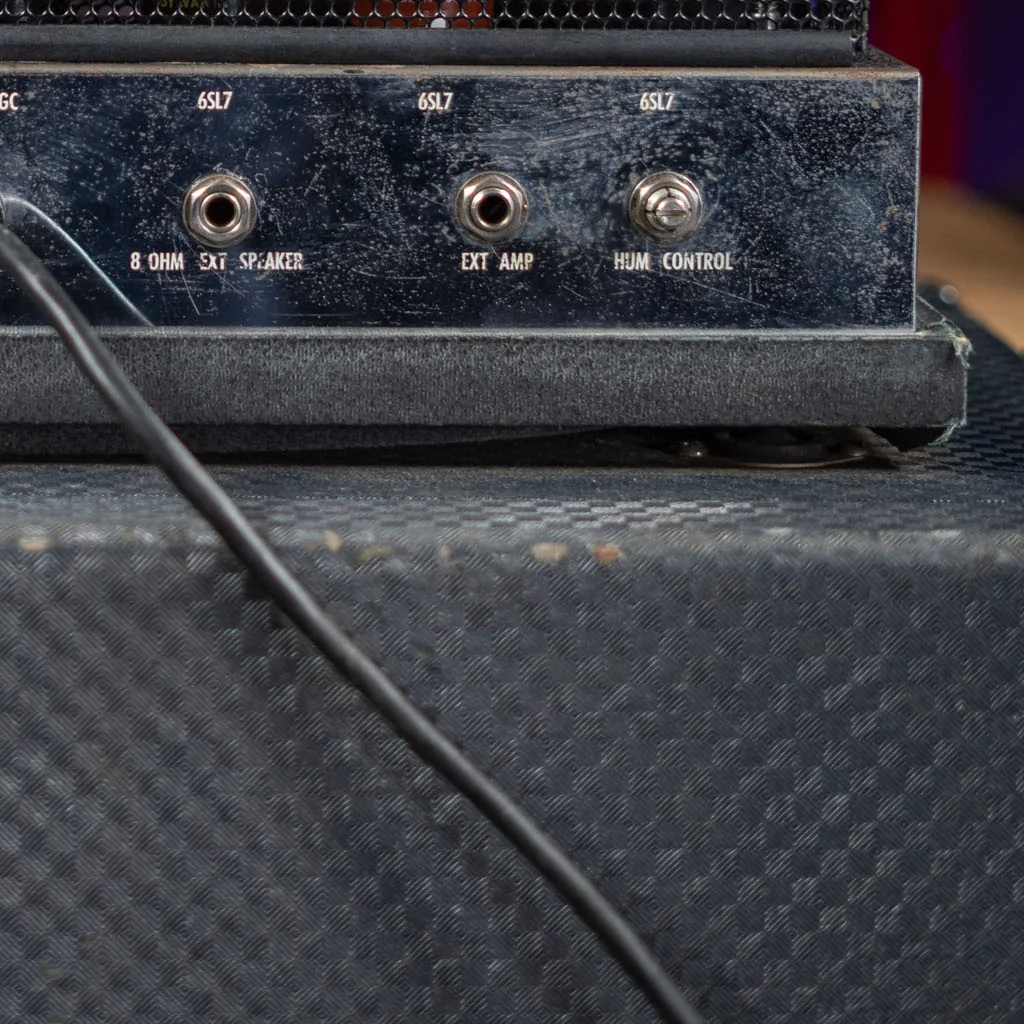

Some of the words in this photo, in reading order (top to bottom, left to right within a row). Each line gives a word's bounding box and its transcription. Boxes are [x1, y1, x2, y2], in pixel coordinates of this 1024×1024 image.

[197, 91, 233, 110] 6SL7
[418, 92, 453, 111] 6SL7
[639, 91, 675, 111] 6SL7
[130, 251, 141, 270] 8
[148, 252, 184, 271] OHM
[199, 252, 227, 270] EXT
[461, 252, 489, 270] EXT
[499, 252, 534, 270] AMP
[614, 252, 651, 270] HUM
[662, 252, 733, 271] CONTROL
